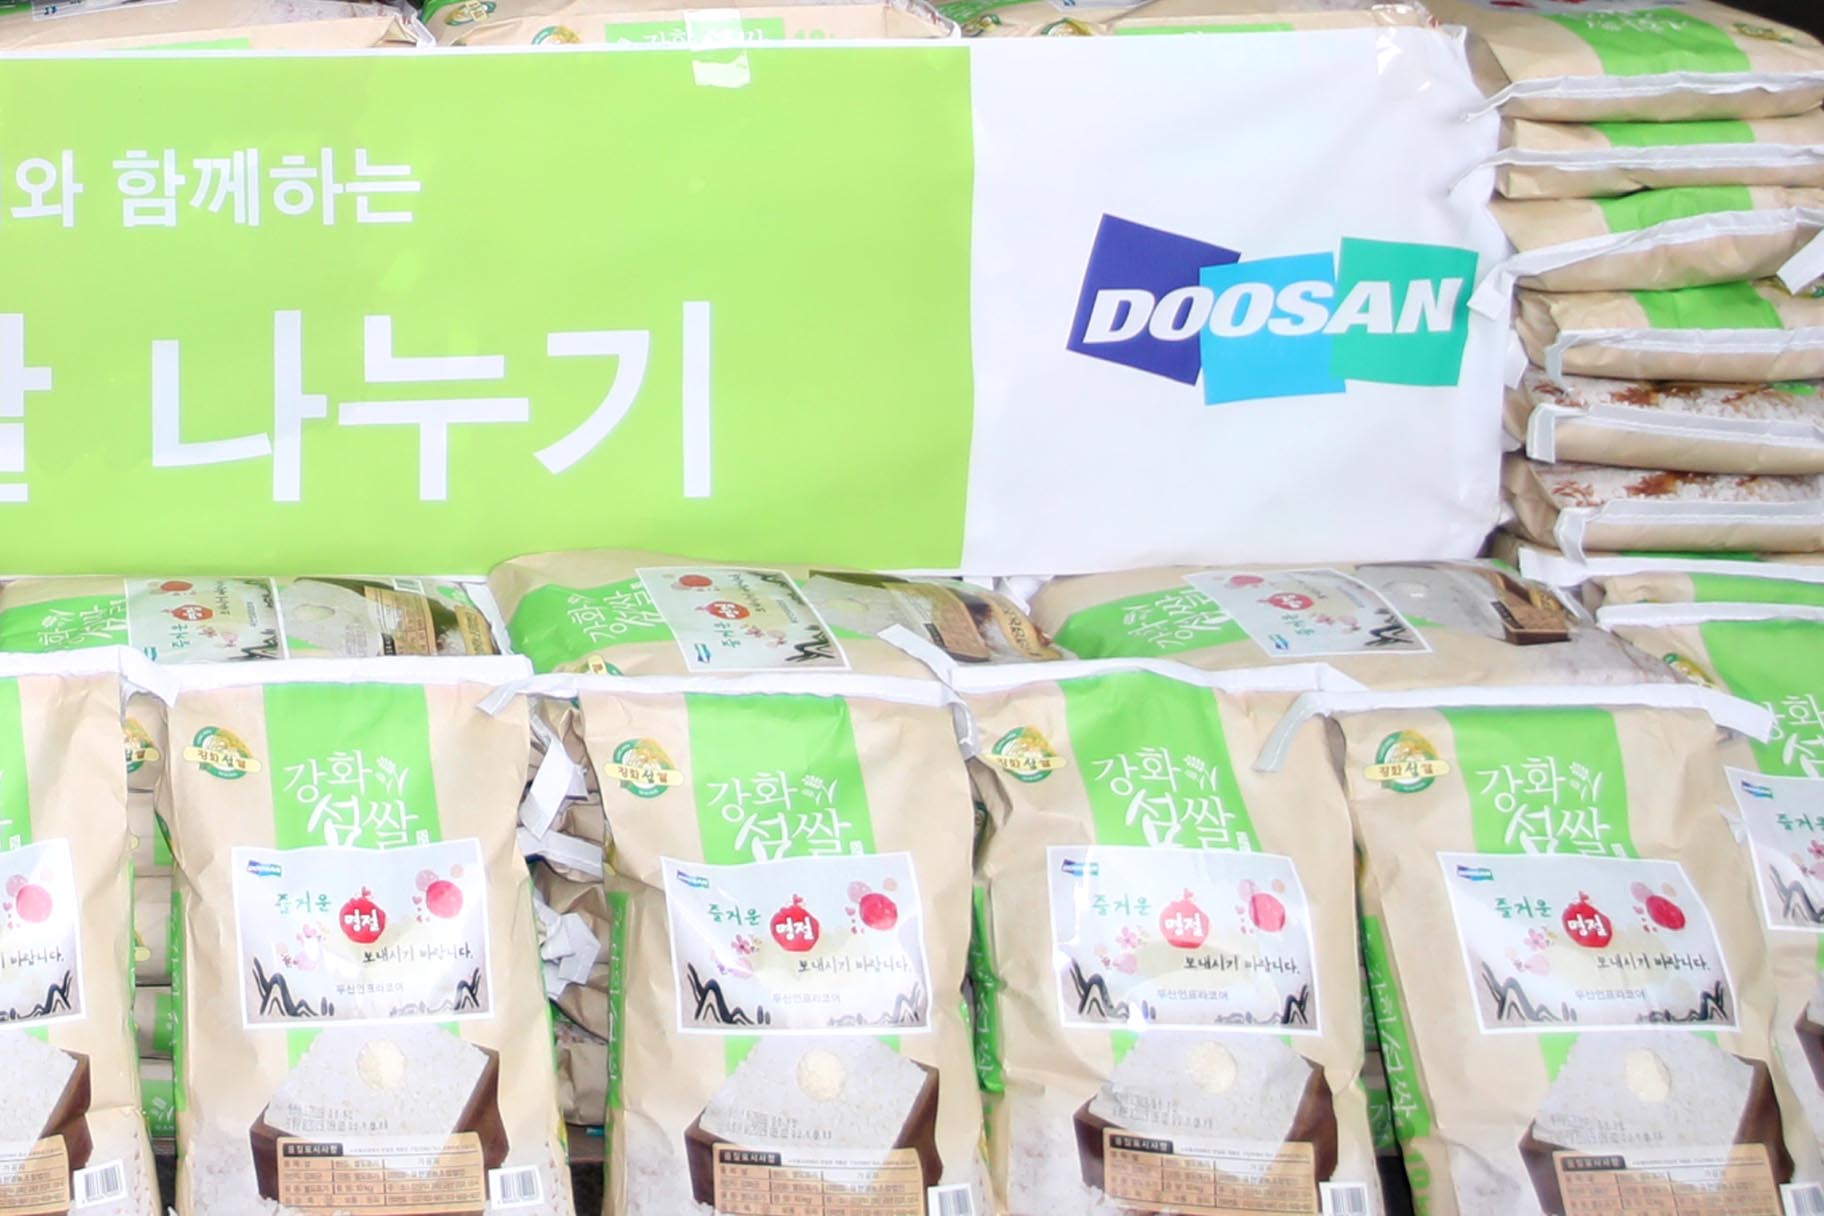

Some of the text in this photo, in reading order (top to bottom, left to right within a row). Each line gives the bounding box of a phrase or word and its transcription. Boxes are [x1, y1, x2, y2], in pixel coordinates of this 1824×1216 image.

[112, 146, 422, 228] 함께하는
[1082, 277, 1464, 344] DOOSAN
[152, 299, 712, 503] 나누기
[283, 750, 375, 803] 강화
[706, 770, 798, 824] 강화
[1091, 746, 1182, 798] 강화
[1476, 755, 1566, 813] 강화
[306, 793, 419, 849] 섬쌀
[735, 808, 853, 861] 섬쌀
[1126, 788, 1236, 852] 섬쌀
[1505, 802, 1611, 857] 섬쌀
[274, 891, 381, 934] 즐거운 명절
[706, 903, 815, 943] 즐거운 명절
[1091, 893, 1205, 937] 즐거운 명절
[1494, 896, 1608, 938] 즐거운 명절
[361, 946, 415, 965] 보내시기
[798, 956, 851, 974] 보내시기
[1183, 953, 1240, 974] 보내시기
[1597, 953, 1651, 971] 보내시기
